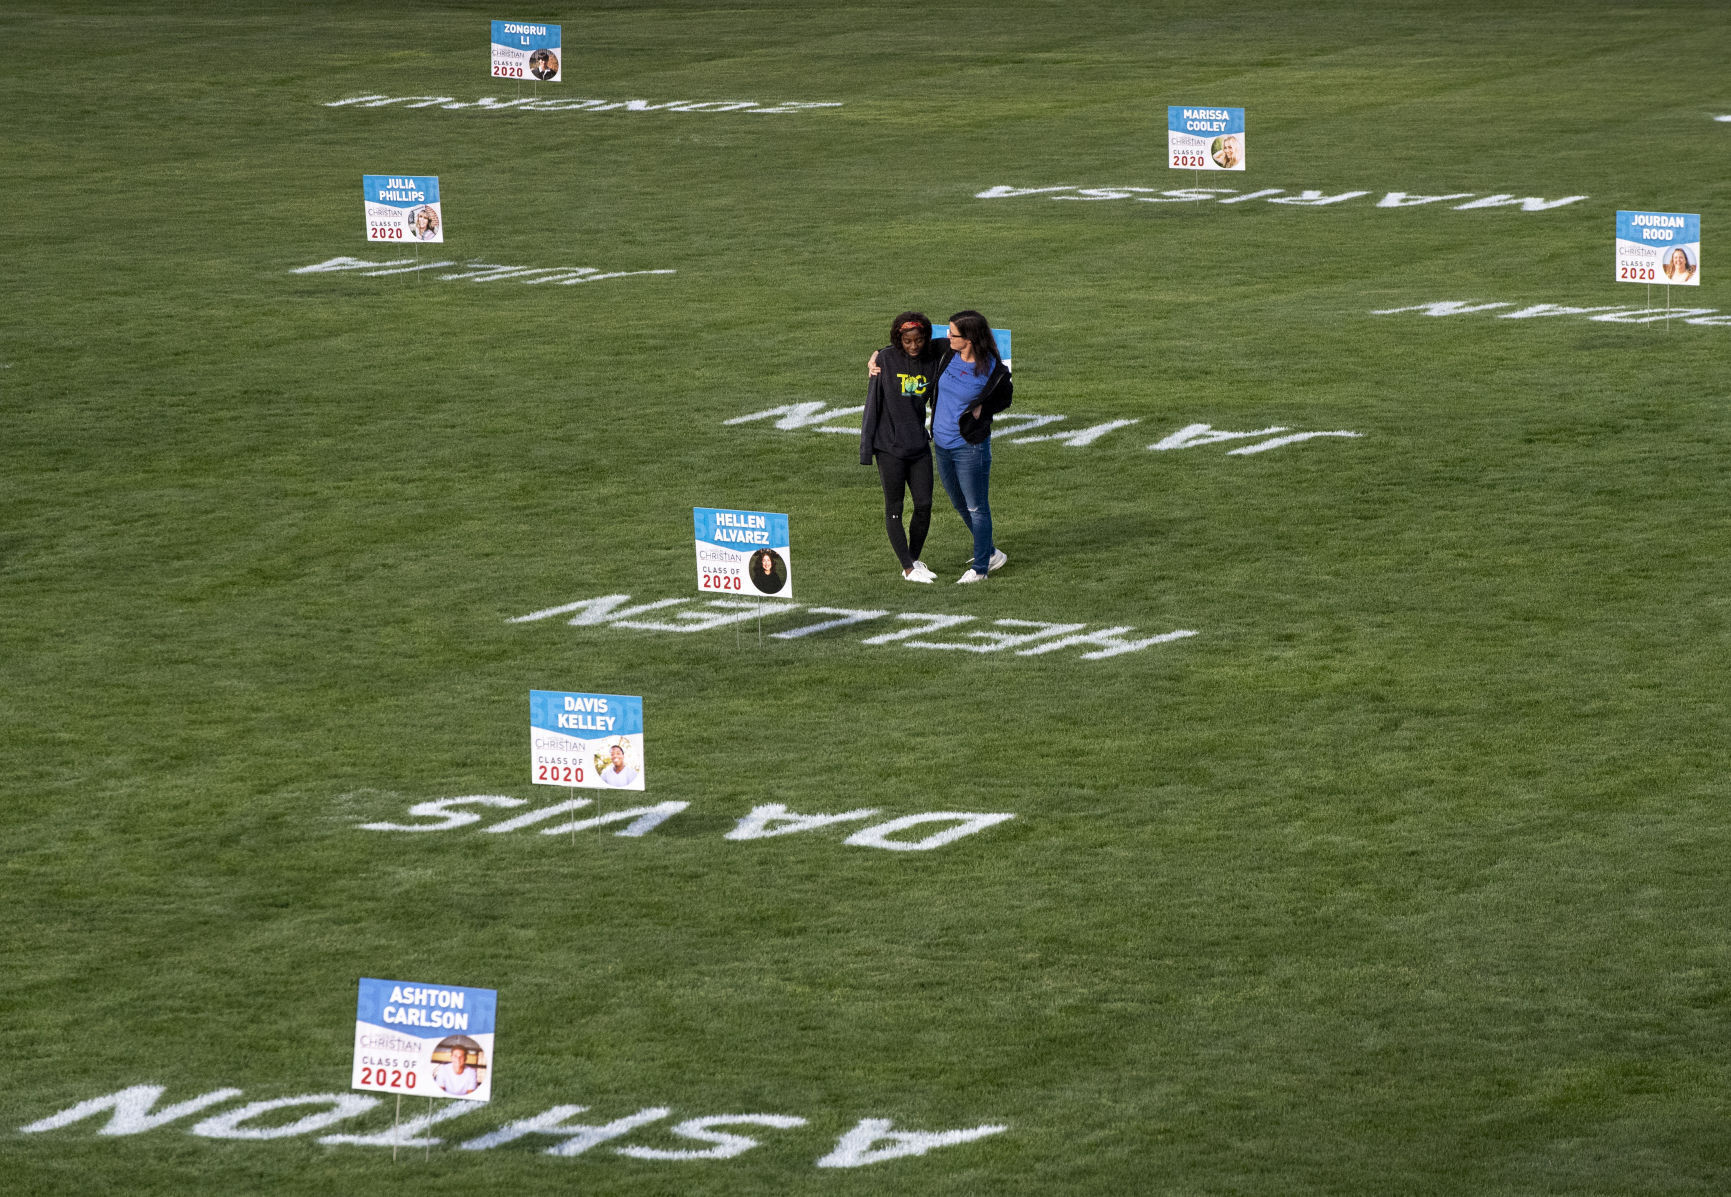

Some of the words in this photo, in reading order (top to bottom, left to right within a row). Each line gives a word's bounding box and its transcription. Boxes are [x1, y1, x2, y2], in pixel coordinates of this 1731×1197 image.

[504, 23, 546, 36] ZONGRUI
[520, 35, 530, 45] LI
[494, 66, 523, 77] 2020
[322, 95, 844, 113] ZONGRUI
[1184, 109, 1230, 120] MARISSA
[1186, 121, 1226, 132] COOLEY
[1171, 138, 1206, 146] CHRISTIAN
[1173, 156, 1204, 166] 2020
[386, 178, 416, 189] JULIA
[379, 190, 425, 202] PHILLIPS
[974, 183, 1590, 212] MARISSA
[368, 208, 402, 218] CHRISTIAN
[1631, 214, 1684, 228] JOURDAN
[372, 228, 402, 239] 2020
[1642, 228, 1674, 240] ROOD
[1619, 247, 1657, 257] CHRISTIAN
[288, 256, 677, 286] JULIA
[1621, 267, 1655, 280] 2020
[716, 512, 765, 529] HELLEN
[714, 528, 770, 545] ALVAREZ
[699, 550, 742, 562] CHRISTIAN
[703, 566, 728, 574] CLASS
[703, 574, 741, 590] 2020
[506, 594, 1199, 661] HELLEN
[564, 696, 608, 713] DAVIS
[558, 713, 616, 731] KELLEY
[535, 738, 586, 752] CHRISTIAN
[538, 756, 568, 765] CLASS
[572, 758, 584, 766] OF
[539, 765, 584, 782] 2020
[357, 795, 1015, 852] DAVIS
[389, 986, 465, 1010] ASHTON
[383, 1006, 469, 1030] CARLSON
[360, 1034, 422, 1053] CHRISTIAN
[362, 1056, 398, 1068] CLASS
[403, 1060, 417, 1068] OF
[361, 1067, 416, 1088] 2020
[17, 1083, 1010, 1169] ASHTON
